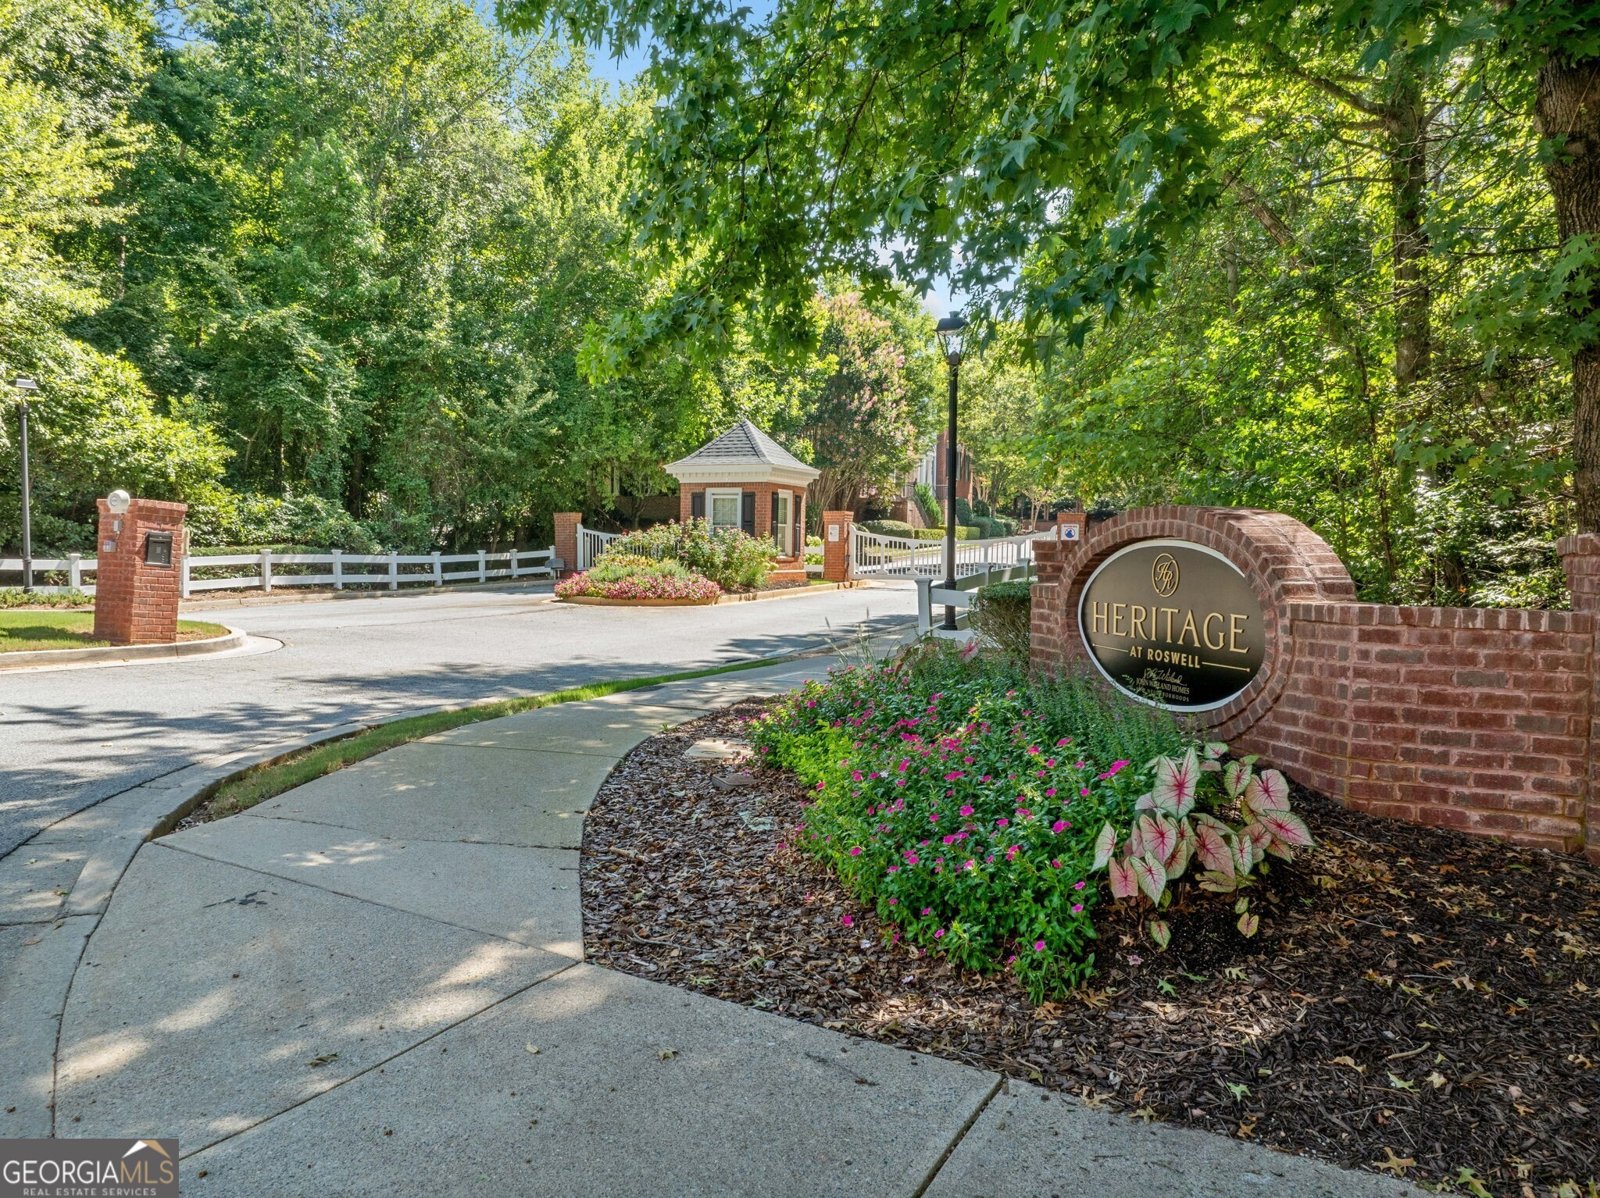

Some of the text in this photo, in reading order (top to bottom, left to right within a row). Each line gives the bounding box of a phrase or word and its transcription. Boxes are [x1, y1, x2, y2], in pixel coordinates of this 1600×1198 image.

[1092, 601, 1250, 654] HERITAGE
[1129, 645, 1201, 669] AT ROSWELL
[1171, 684, 1190, 695] HOMES
